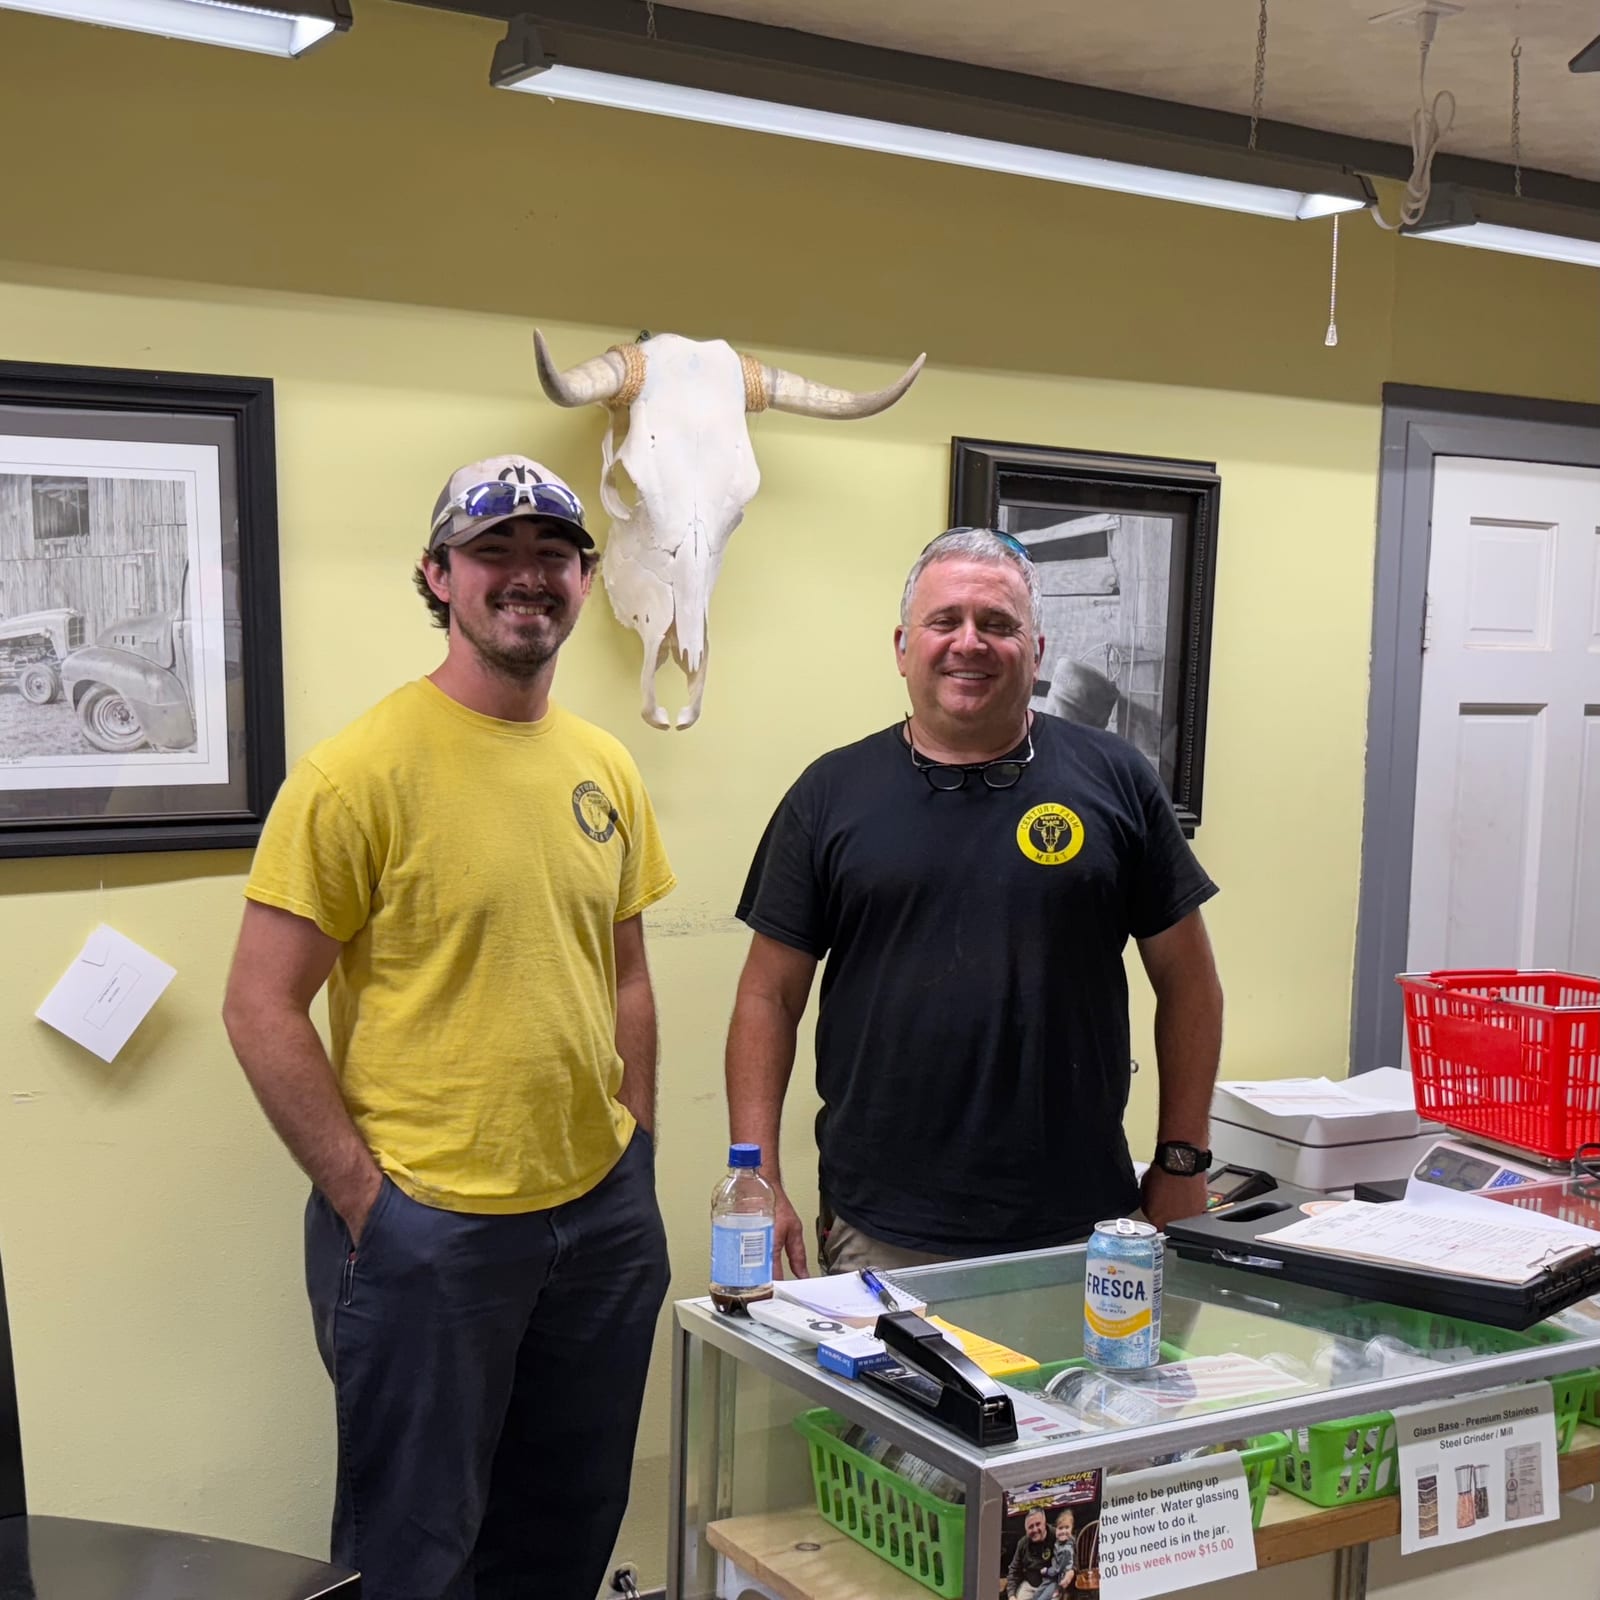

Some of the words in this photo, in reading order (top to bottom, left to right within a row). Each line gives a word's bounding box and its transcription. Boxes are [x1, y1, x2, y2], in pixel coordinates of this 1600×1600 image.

[1020, 805, 1055, 830] CENTURY
[1060, 808, 1081, 829] FARM
[1035, 852, 1068, 863] MEAT
[1087, 1272, 1146, 1302] FRESCA
[1413, 1427, 1436, 1438] Glass
[1438, 1422, 1460, 1433] Base
[1466, 1414, 1502, 1426] Premium
[1503, 1406, 1539, 1419] Stainless
[1440, 1439, 1462, 1450] Steel
[1463, 1432, 1494, 1445] Grinder
[1500, 1426, 1514, 1437] Mill
[1111, 1493, 1135, 1507] time
[1137, 1491, 1148, 1503] to
[1150, 1486, 1164, 1499] be
[1166, 1479, 1204, 1498] putting
[1205, 1476, 1219, 1489] up
[1101, 1515, 1119, 1527] the
[1121, 1506, 1159, 1522] winter.
[1161, 1499, 1193, 1513] Water
[1195, 1488, 1239, 1507] glassing
[1099, 1533, 1108, 1545] h
[1110, 1529, 1131, 1545] you
[1133, 1523, 1156, 1536] how
[1158, 1519, 1170, 1531] to
[1171, 1516, 1186, 1528] do
[1188, 1513, 1198, 1524] it.
[1118, 1545, 1138, 1561] you
[1140, 1538, 1167, 1553] need
[1170, 1535, 1179, 1546] is
[1181, 1532, 1191, 1544] in
[1193, 1528, 1210, 1541] the
[1212, 1524, 1230, 1540] jar.
[1099, 1565, 1119, 1580] .00
[1121, 1562, 1141, 1575] this
[1144, 1555, 1172, 1569] week
[1174, 1549, 1197, 1561] now
[1199, 1538, 1234, 1556] $15.00
